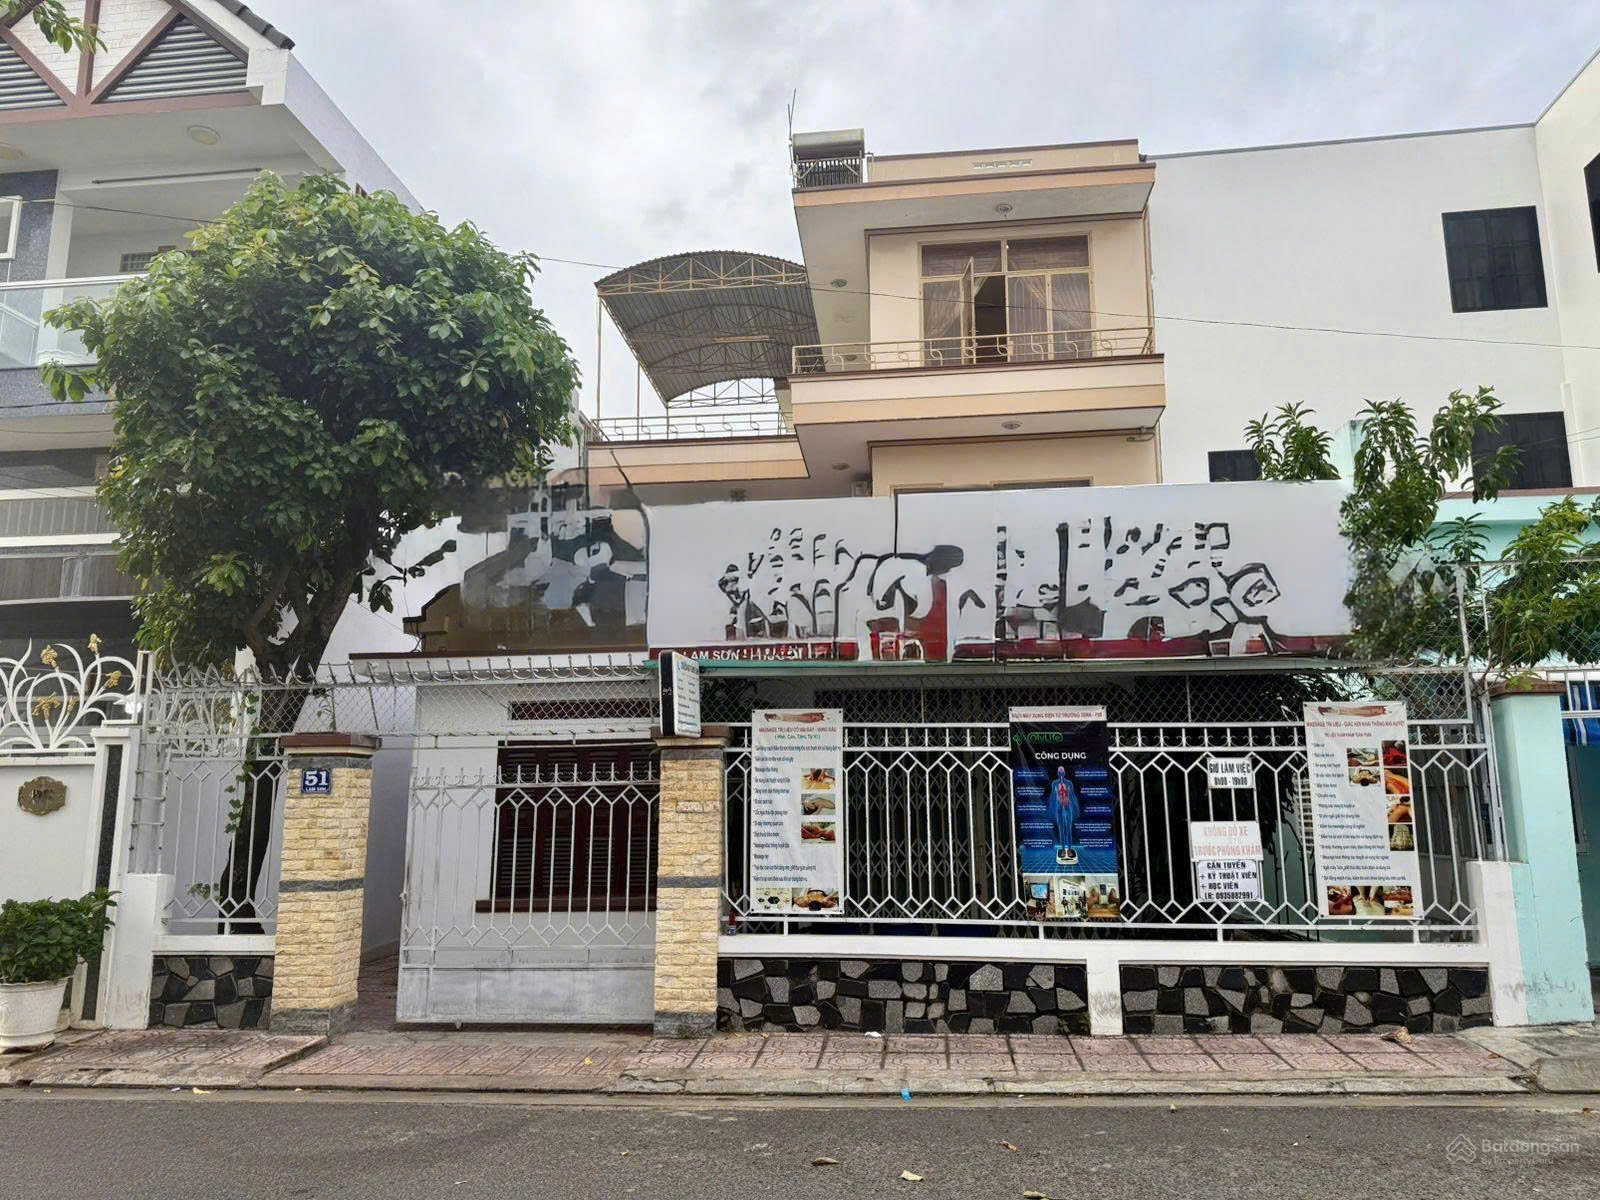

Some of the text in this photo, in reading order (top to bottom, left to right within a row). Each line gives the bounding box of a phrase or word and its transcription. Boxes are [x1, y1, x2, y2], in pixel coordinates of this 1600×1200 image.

[1034, 751, 1087, 761] CÔNG DỤNG
[1220, 761, 1234, 773] LÀM
[1235, 761, 1251, 775] VIỆC
[305, 770, 329, 786] 51
[1204, 824, 1227, 836] KHÔNG
[1239, 826, 1249, 836] XE
[1217, 845, 1241, 856] PHÒNG
[1241, 844, 1262, 856] KHÁM
[1207, 860, 1246, 869] CẦN TUYỂN
[1219, 871, 1239, 881] THUẬT
[1241, 870, 1257, 879] VIÊN
